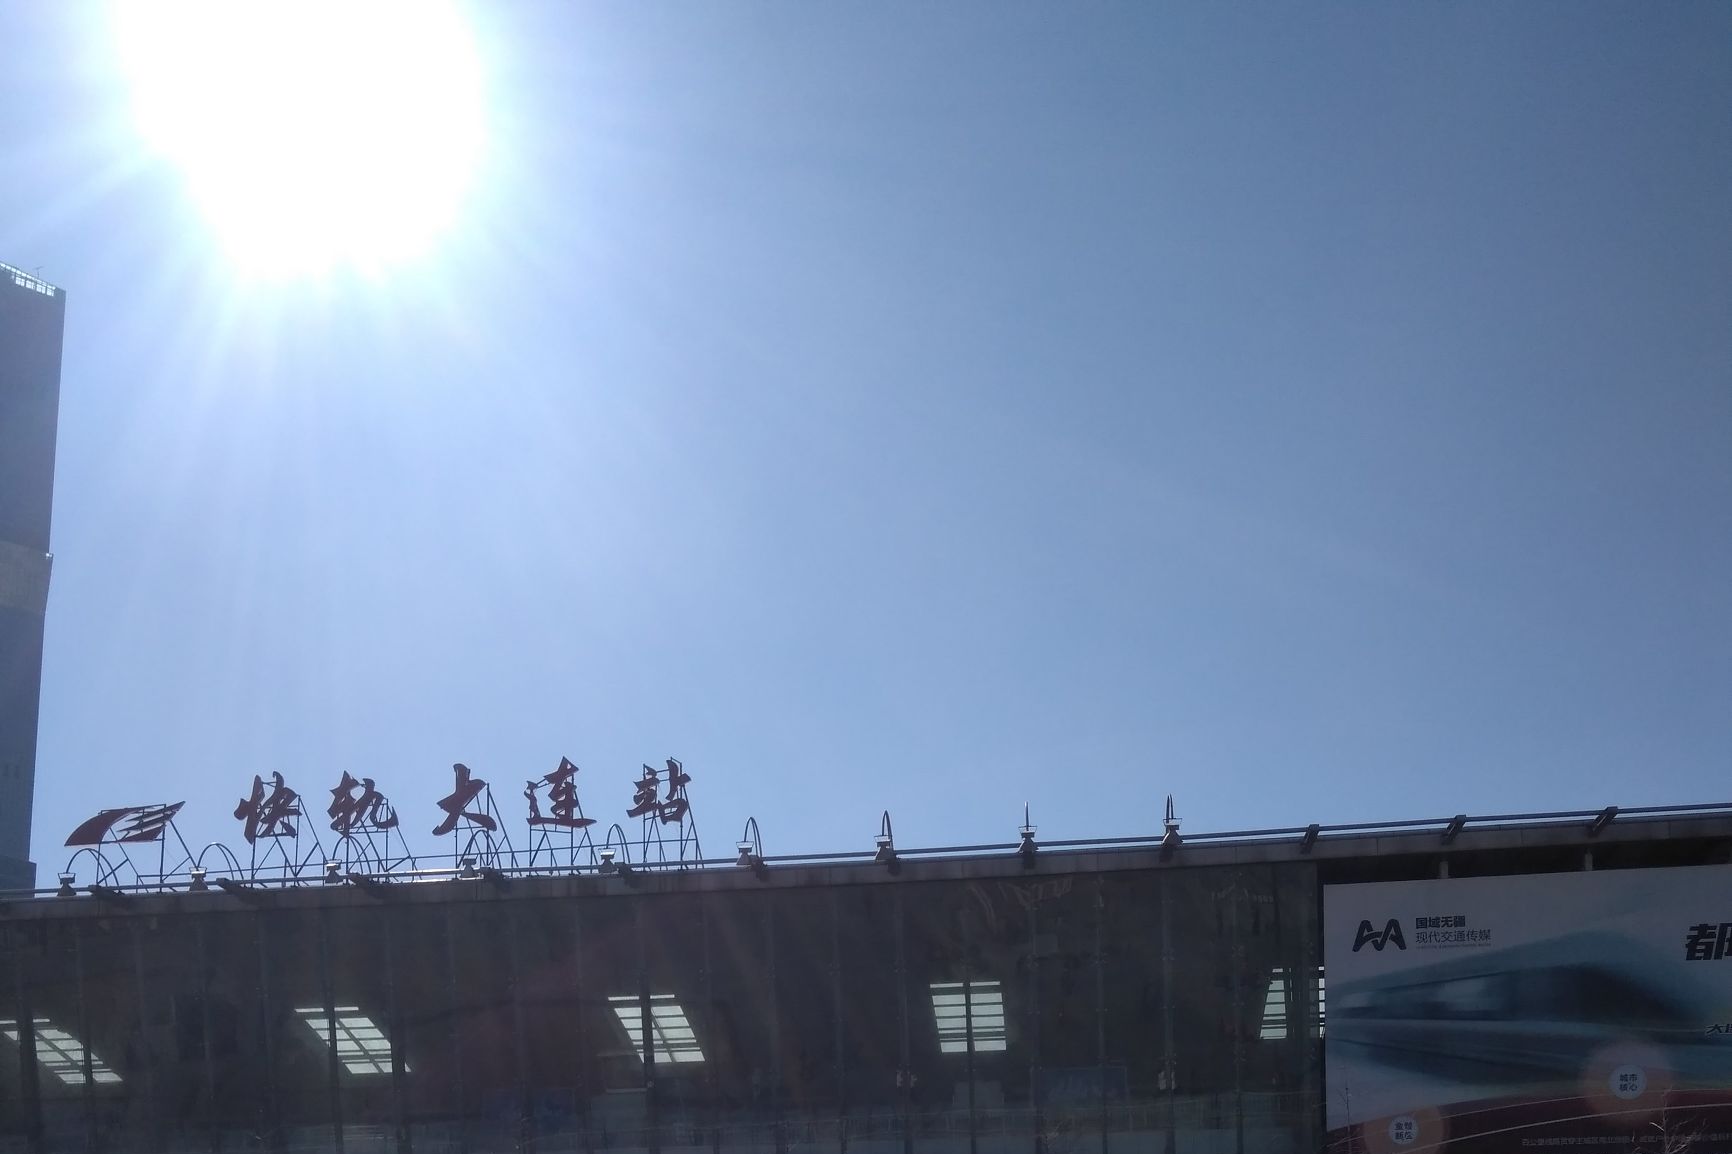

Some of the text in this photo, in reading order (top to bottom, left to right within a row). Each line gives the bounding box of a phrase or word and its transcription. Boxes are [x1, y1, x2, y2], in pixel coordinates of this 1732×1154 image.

[234, 756, 692, 844] 快轨大连站
[1415, 929, 1492, 944] 现代交通传媒
